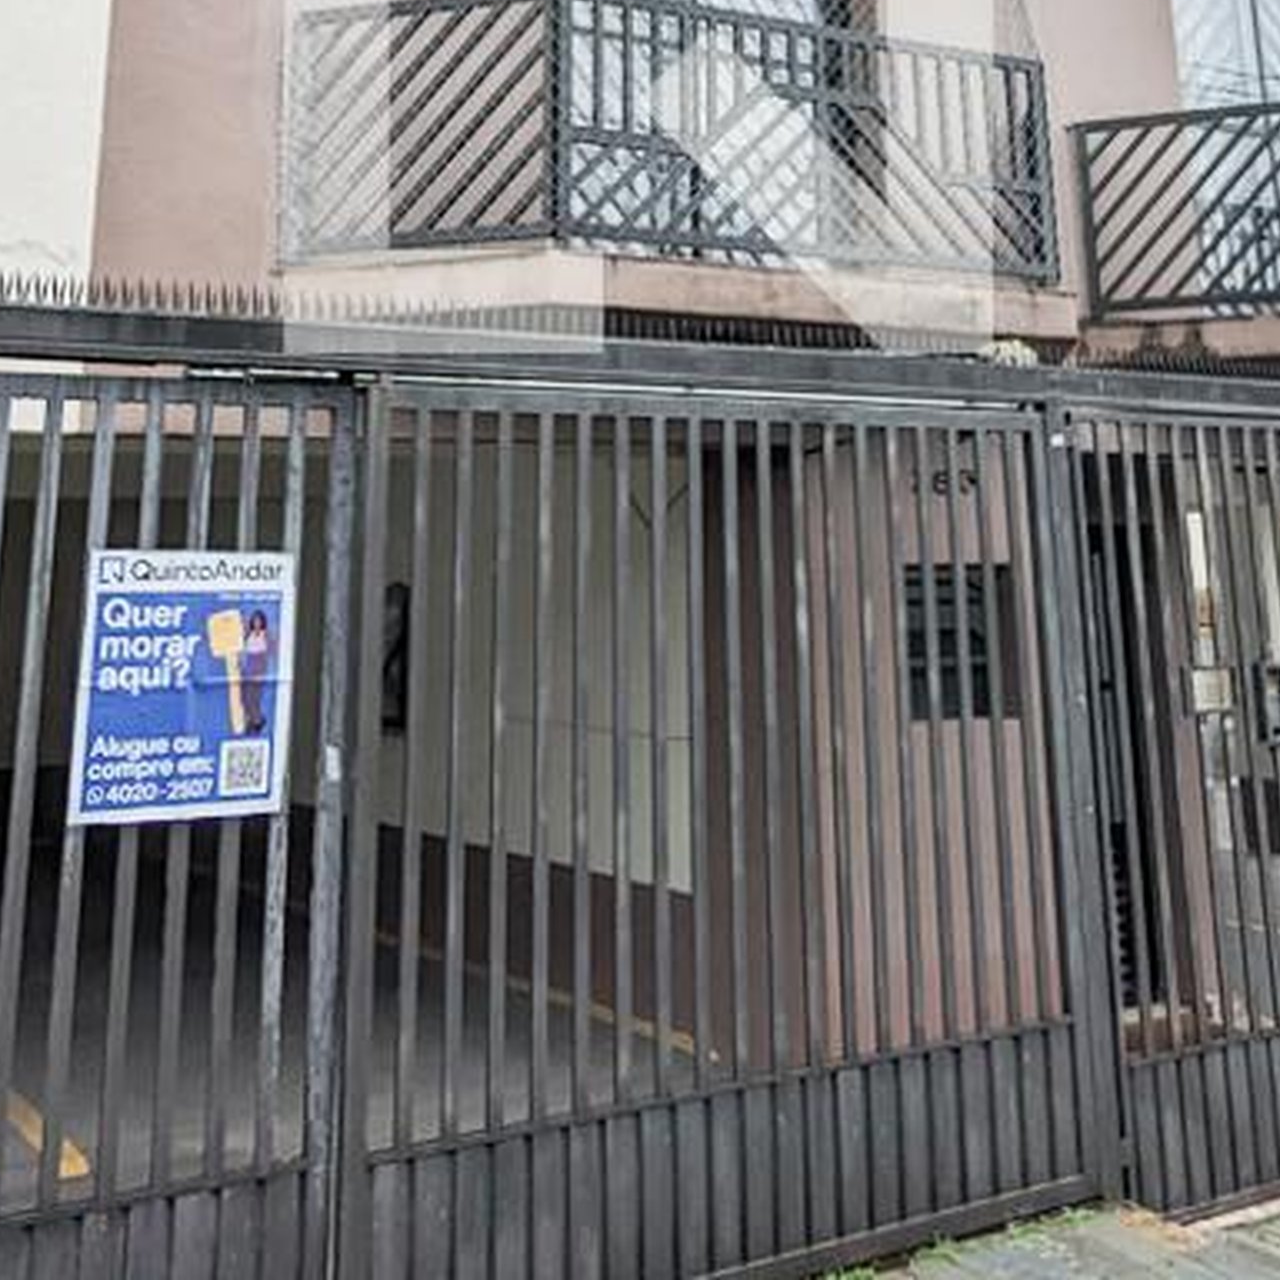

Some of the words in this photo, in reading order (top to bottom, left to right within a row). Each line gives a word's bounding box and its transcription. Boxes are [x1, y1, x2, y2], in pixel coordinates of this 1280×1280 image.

[130, 558, 283, 582] QuintoAndar
[102, 596, 187, 629] Quer
[99, 632, 201, 660] morar
[97, 658, 192, 695] aqui?
[89, 734, 169, 761] Alugue
[172, 735, 201, 754] ou
[86, 758, 174, 782] compre
